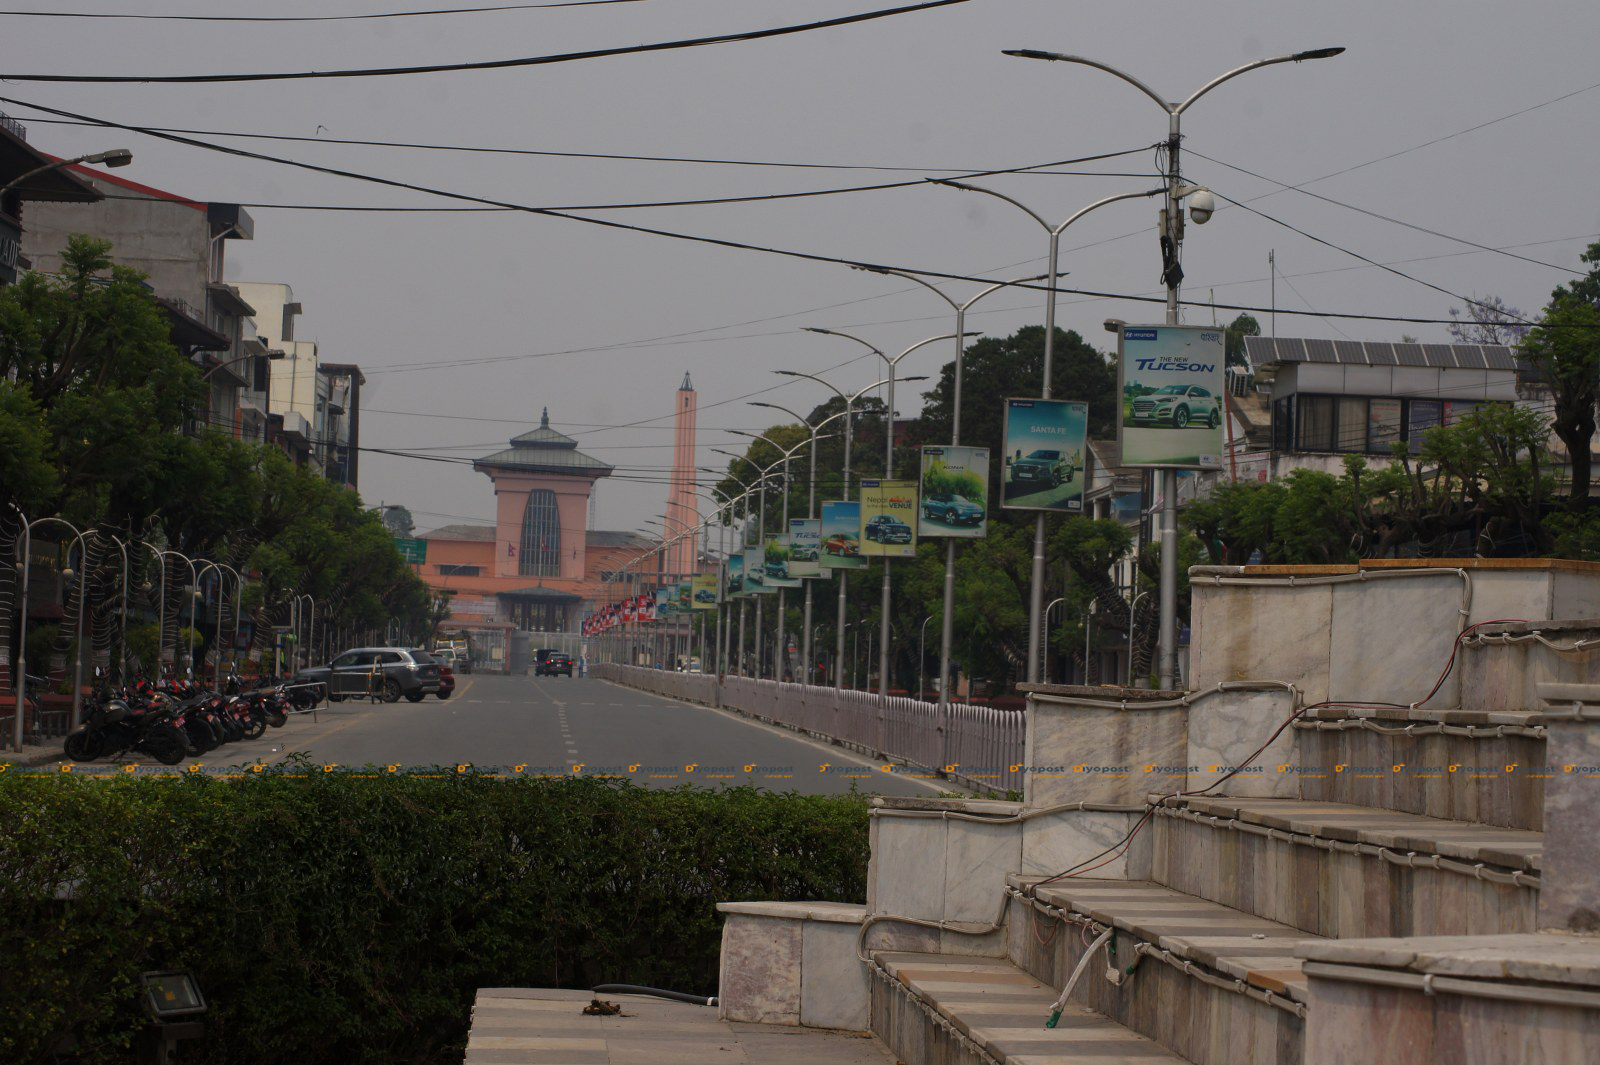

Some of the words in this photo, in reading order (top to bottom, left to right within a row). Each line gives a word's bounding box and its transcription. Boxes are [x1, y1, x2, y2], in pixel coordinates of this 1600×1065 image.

[1135, 357, 1215, 373] TUCSON
[1030, 425, 1056, 434] SANTA
[889, 502, 913, 510] VENUE
